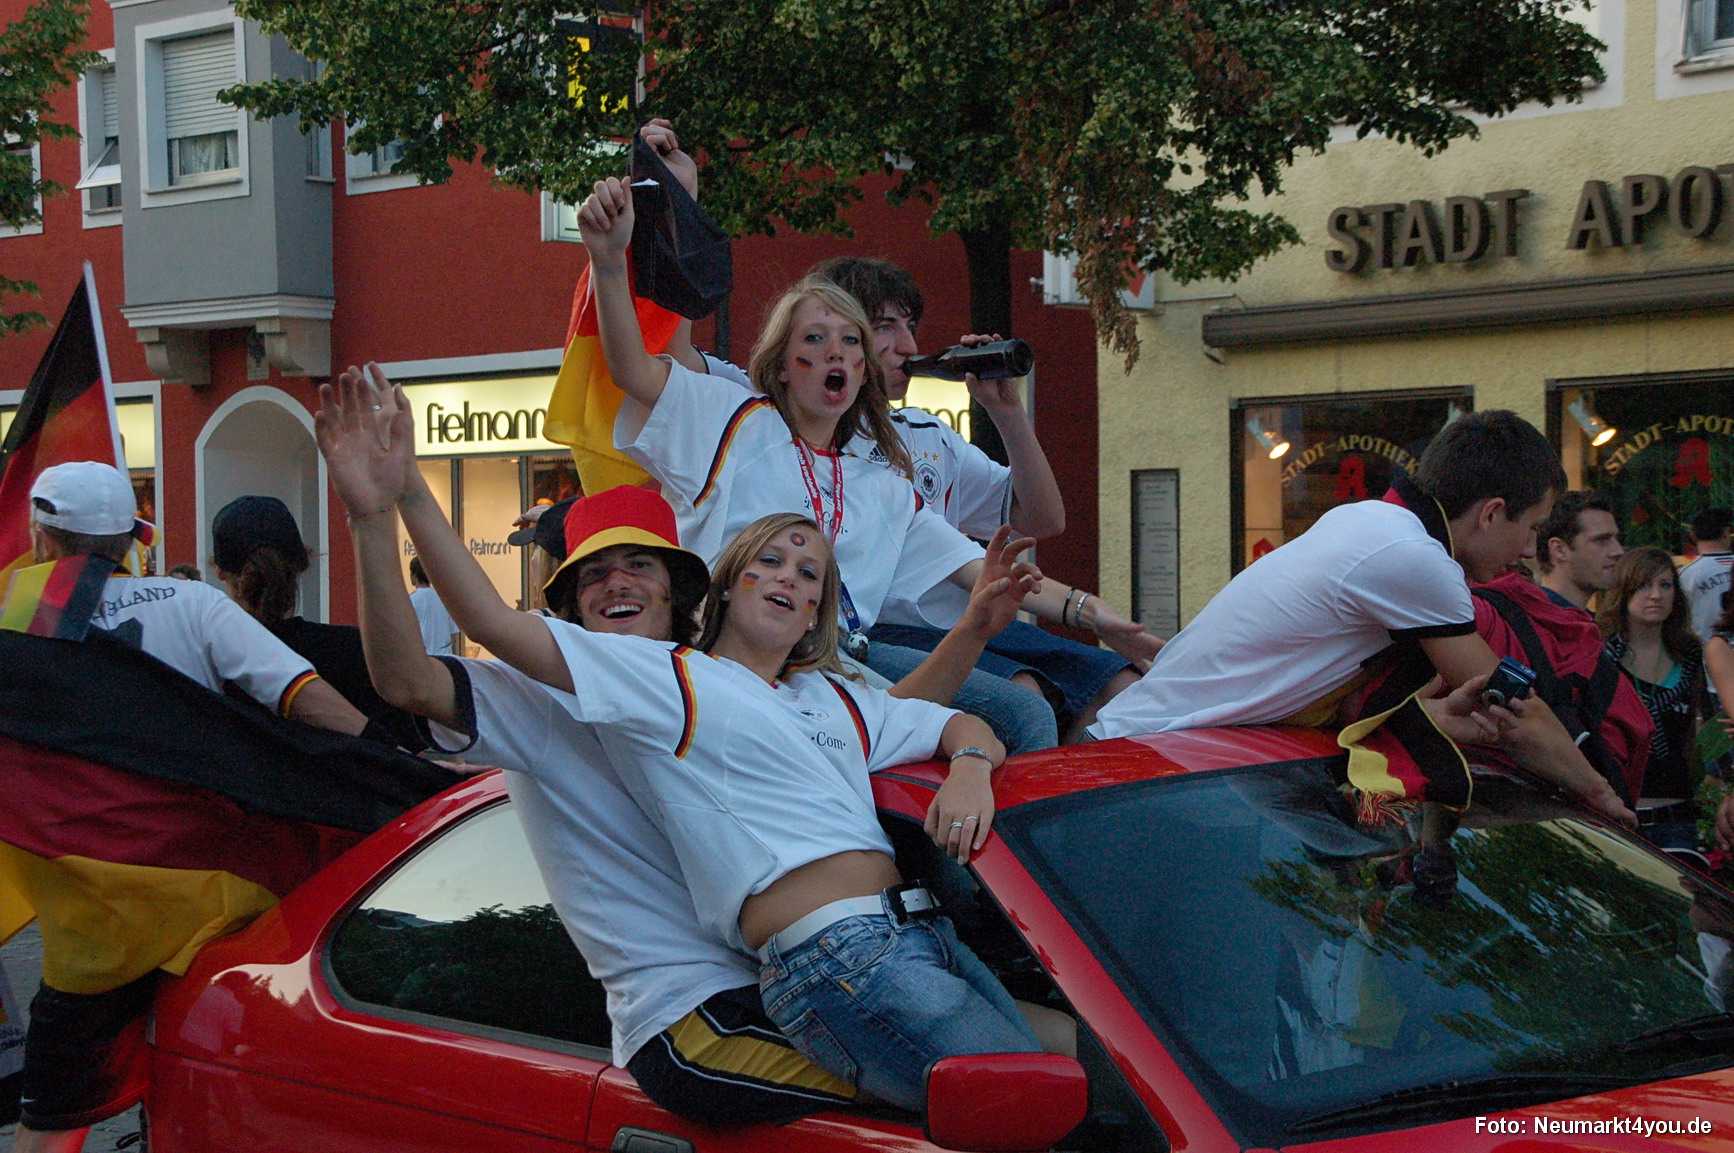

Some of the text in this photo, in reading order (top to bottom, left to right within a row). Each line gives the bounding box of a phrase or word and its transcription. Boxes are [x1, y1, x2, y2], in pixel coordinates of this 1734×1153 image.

[1325, 188, 1531, 274] STADT
[1281, 434, 1420, 488] STADT-APOTHEK
[1696, 571, 1731, 594] MATT
